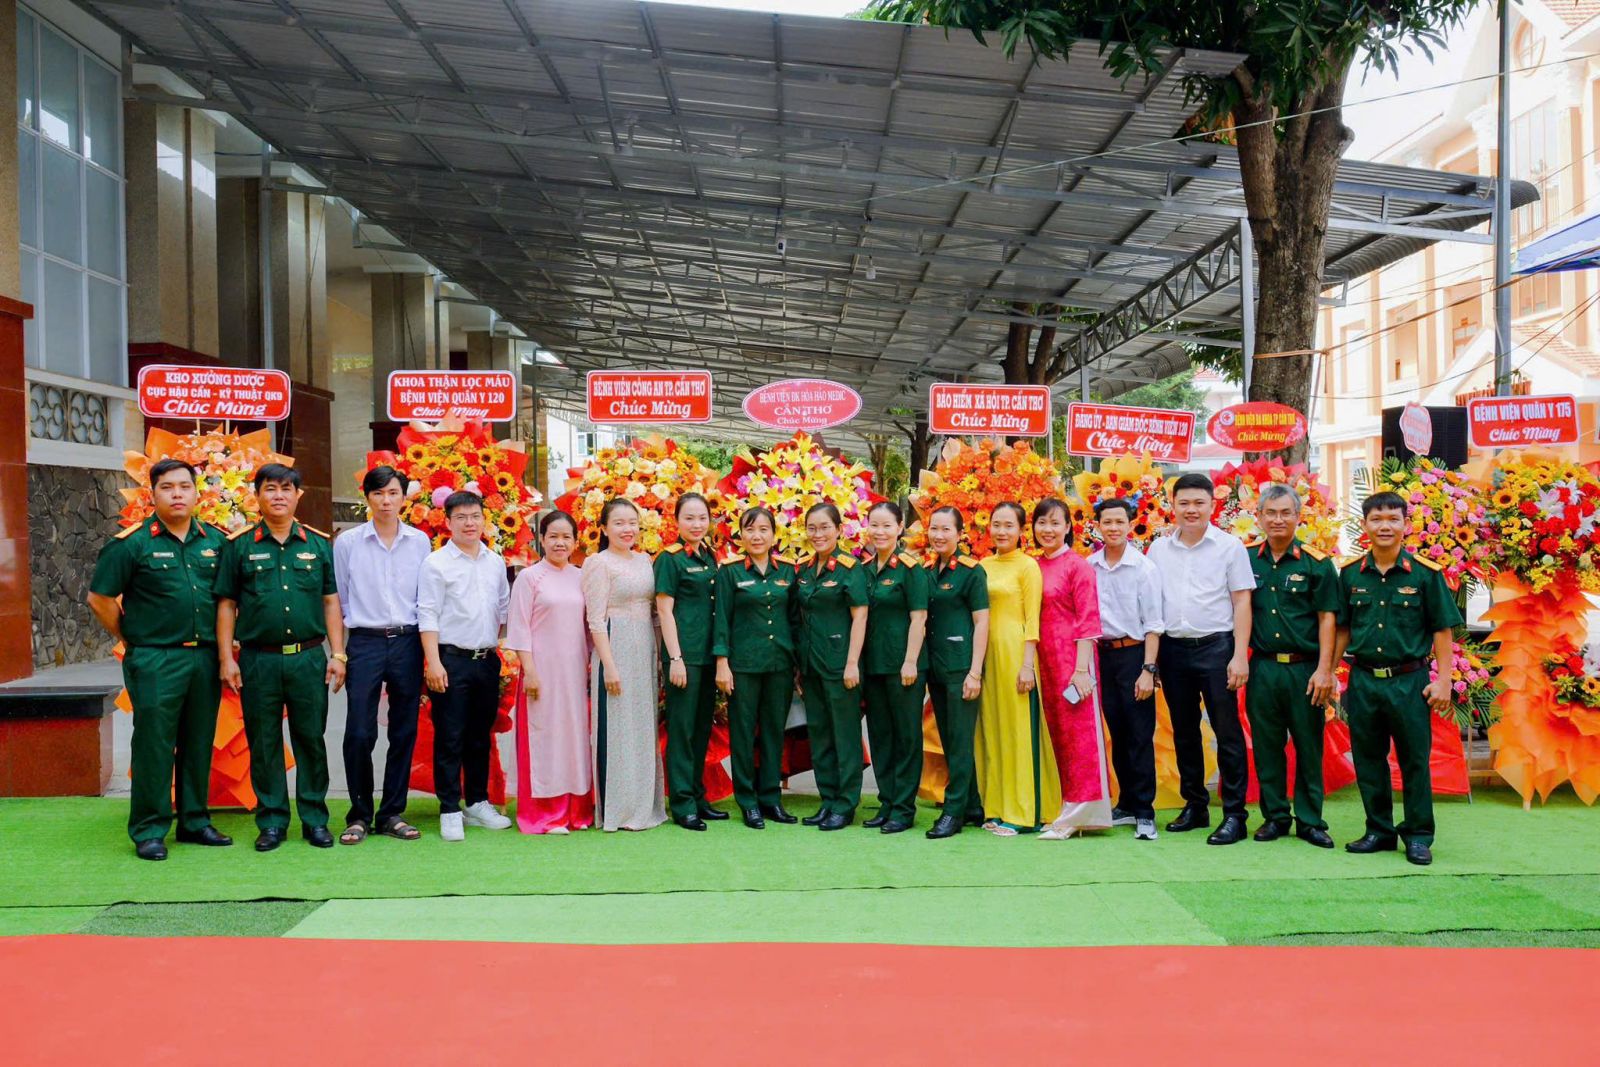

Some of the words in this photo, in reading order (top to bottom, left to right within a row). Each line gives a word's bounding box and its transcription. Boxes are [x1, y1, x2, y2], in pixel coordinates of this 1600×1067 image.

[165, 372, 190, 384] KHO
[192, 370, 232, 386] XƯỞNG
[234, 374, 265, 387] DƯỢC
[394, 377, 425, 387] KHOA
[428, 375, 458, 389] THẬN
[461, 377, 482, 389] LỌC
[485, 375, 510, 387] MÁU
[147, 386, 166, 398] CỤC
[169, 387, 188, 399] HẬU
[234, 389, 262, 401] THUẬT
[593, 376, 613, 400] BỆNH
[614, 376, 631, 400] VIỆN
[631, 376, 653, 397] CÔNG
[653, 381, 663, 397] AN
[675, 375, 690, 397] CẦN
[691, 379, 706, 397] THƠ
[400, 389, 425, 405] BỆNH
[427, 389, 449, 405] VIỆN
[452, 390, 477, 405] QUÂN
[479, 392, 486, 403] Y
[488, 392, 505, 403] 120
[760, 389, 776, 403] BỆNH
[776, 389, 790, 403] VIỆN
[827, 390, 846, 401] MEDIC
[936, 388, 952, 408] BẢO
[975, 390, 985, 409] XÃ
[986, 390, 1000, 413] HỘI
[1011, 390, 1027, 410] CẦN
[1029, 394, 1044, 411] THƠ
[163, 399, 210, 414] Chúc
[609, 400, 647, 416] Chúc
[650, 400, 692, 418] Mừng
[774, 403, 801, 416] CẦN
[802, 405, 832, 415] THƠ
[1474, 403, 1498, 424] BỆNH
[1499, 402, 1520, 423] VIỆN
[1522, 401, 1546, 421] QUÂN
[1548, 403, 1554, 418] Y
[1556, 402, 1572, 418] 175
[777, 417, 800, 425] Chúc
[950, 412, 987, 427] Chúc
[990, 413, 1030, 432] Mừng
[1237, 431, 1259, 441] Chúc
[1489, 427, 1520, 442] Chúc
[1086, 430, 1126, 453] Chúc
[1127, 434, 1174, 458] Mừng
